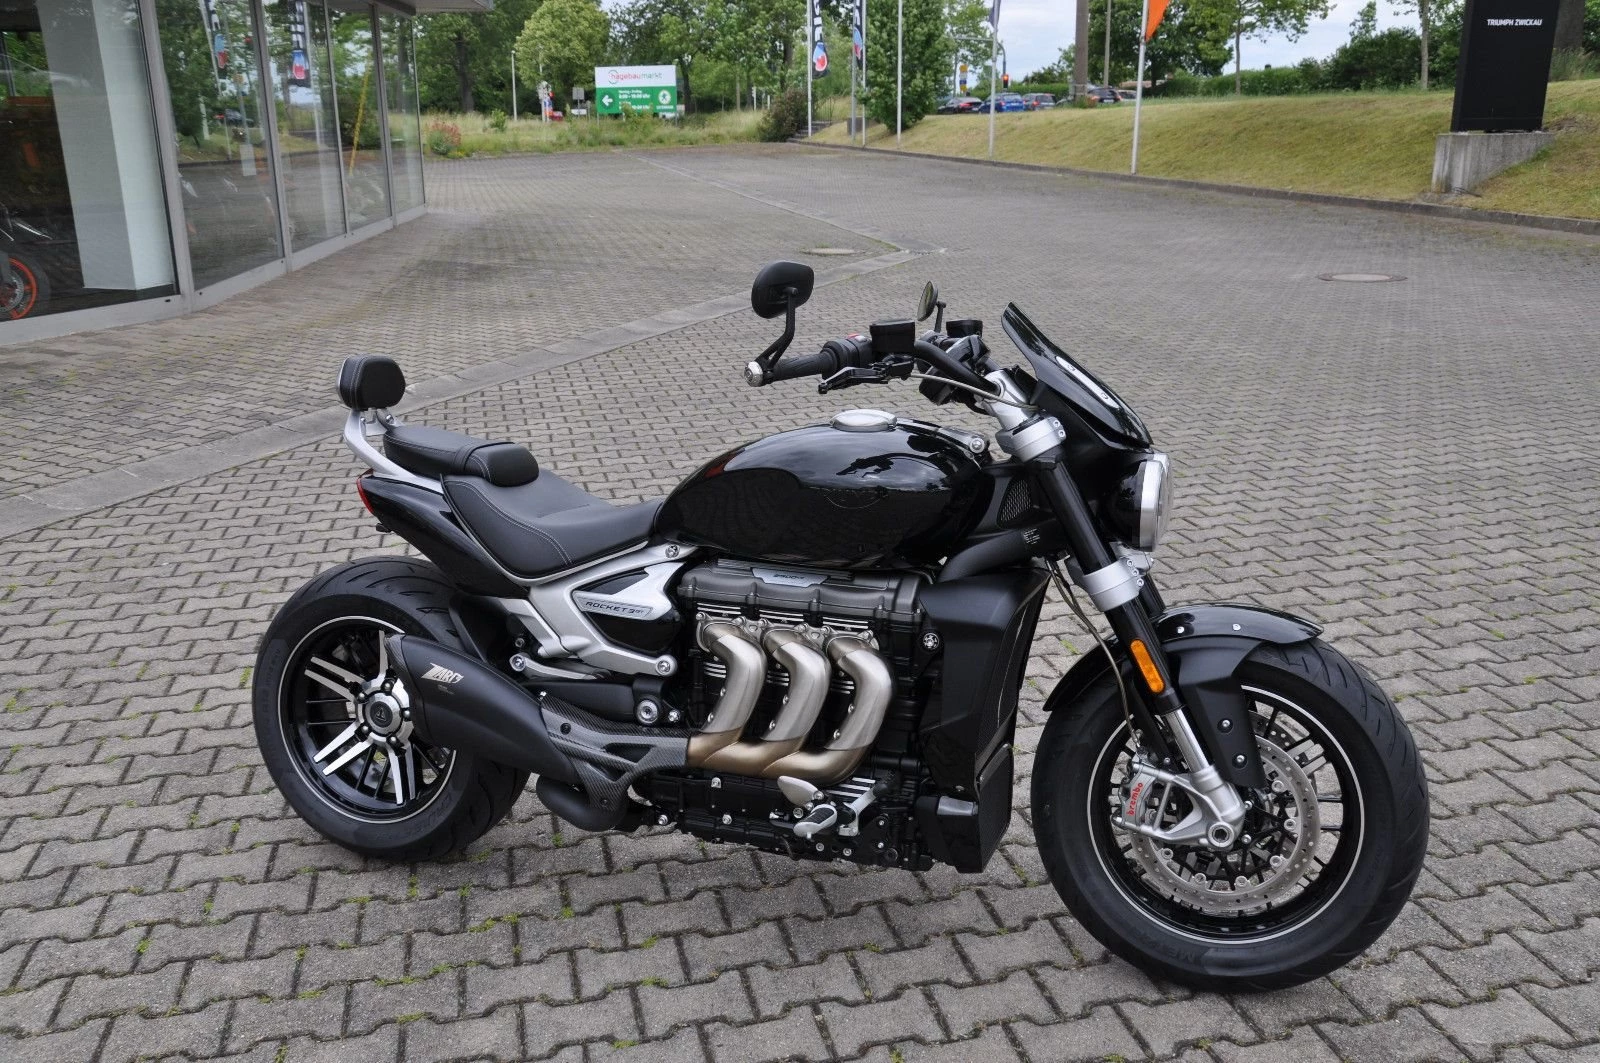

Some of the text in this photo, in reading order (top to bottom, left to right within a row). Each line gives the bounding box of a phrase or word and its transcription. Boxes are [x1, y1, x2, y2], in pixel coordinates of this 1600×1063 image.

[1487, 18, 1543, 26] TRIUMPH ZWICKAU
[585, 601, 628, 612] ROCKET
[1125, 782, 1143, 816] brembo
